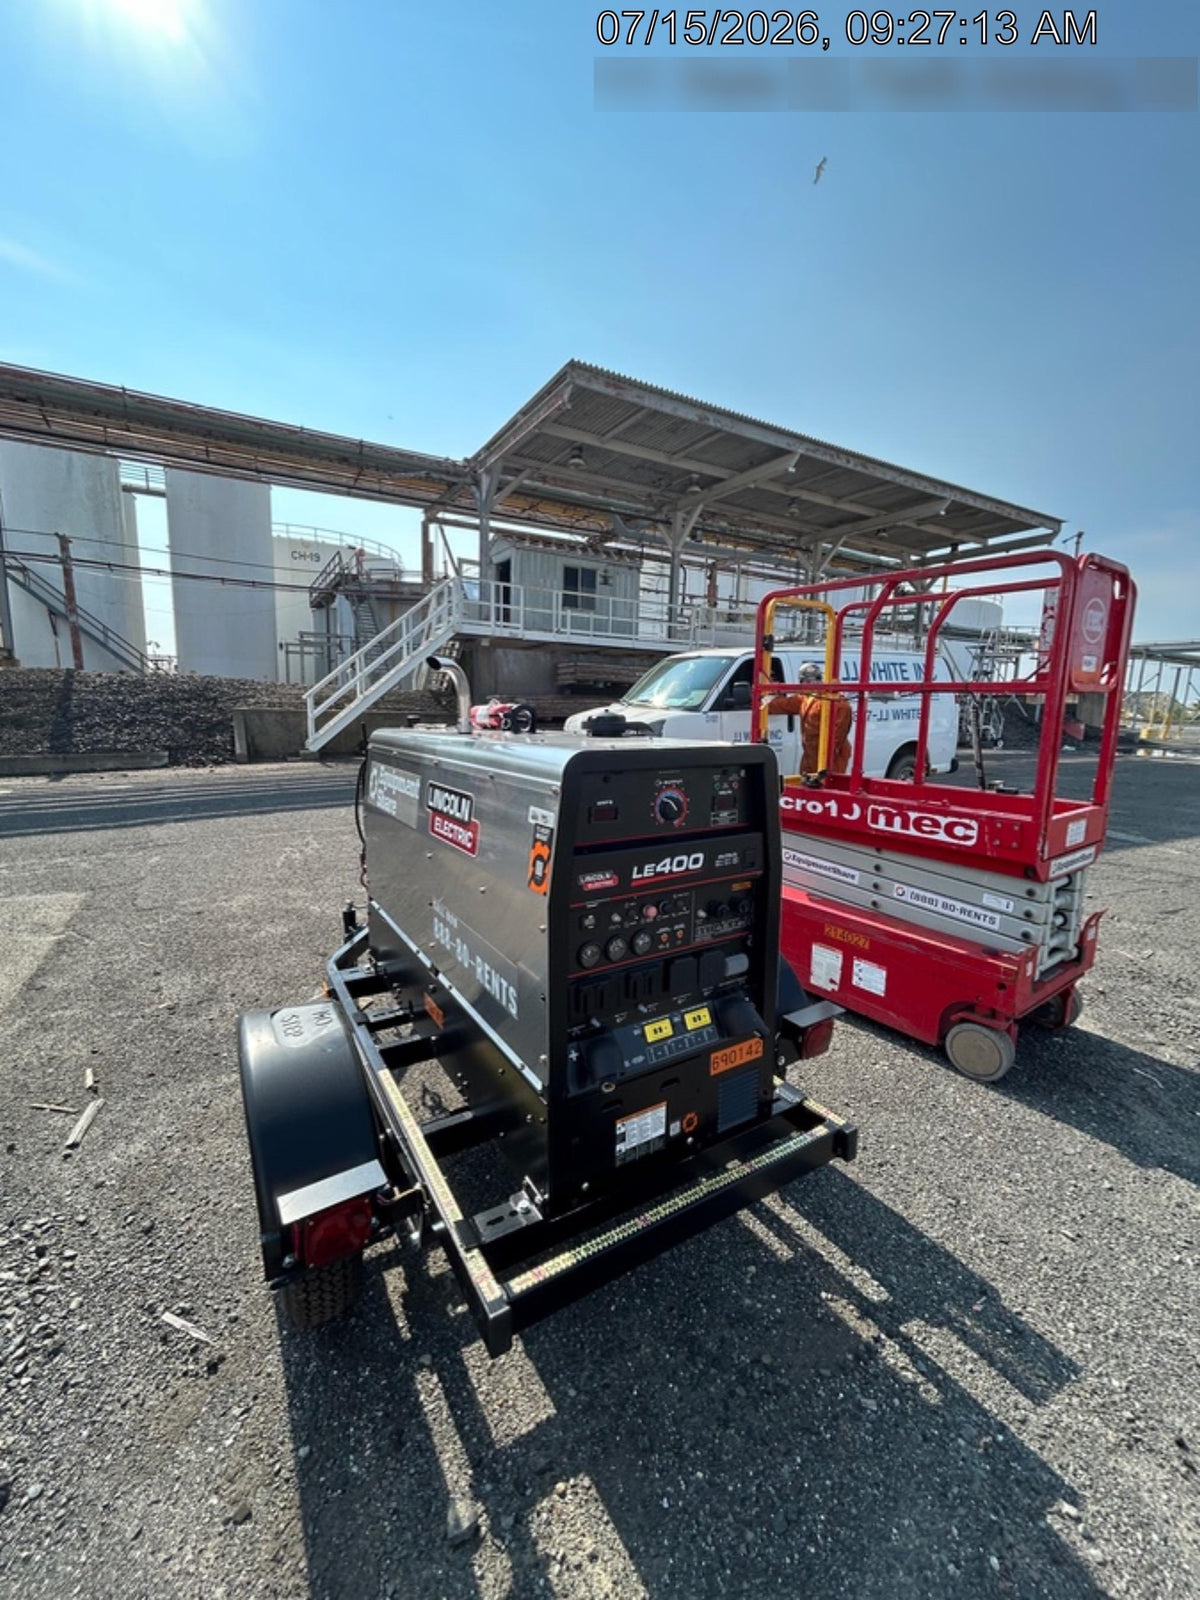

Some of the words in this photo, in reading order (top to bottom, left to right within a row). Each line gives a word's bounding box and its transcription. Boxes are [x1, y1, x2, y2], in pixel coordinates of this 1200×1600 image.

[842, 661, 858, 681] JJ
[912, 662, 938, 681] IN
[891, 708, 921, 721] WHITE
[428, 787, 470, 822] LINCOLN
[434, 816, 474, 848] ELECTRIC
[868, 804, 978, 845] mec
[631, 852, 705, 880] LE400
